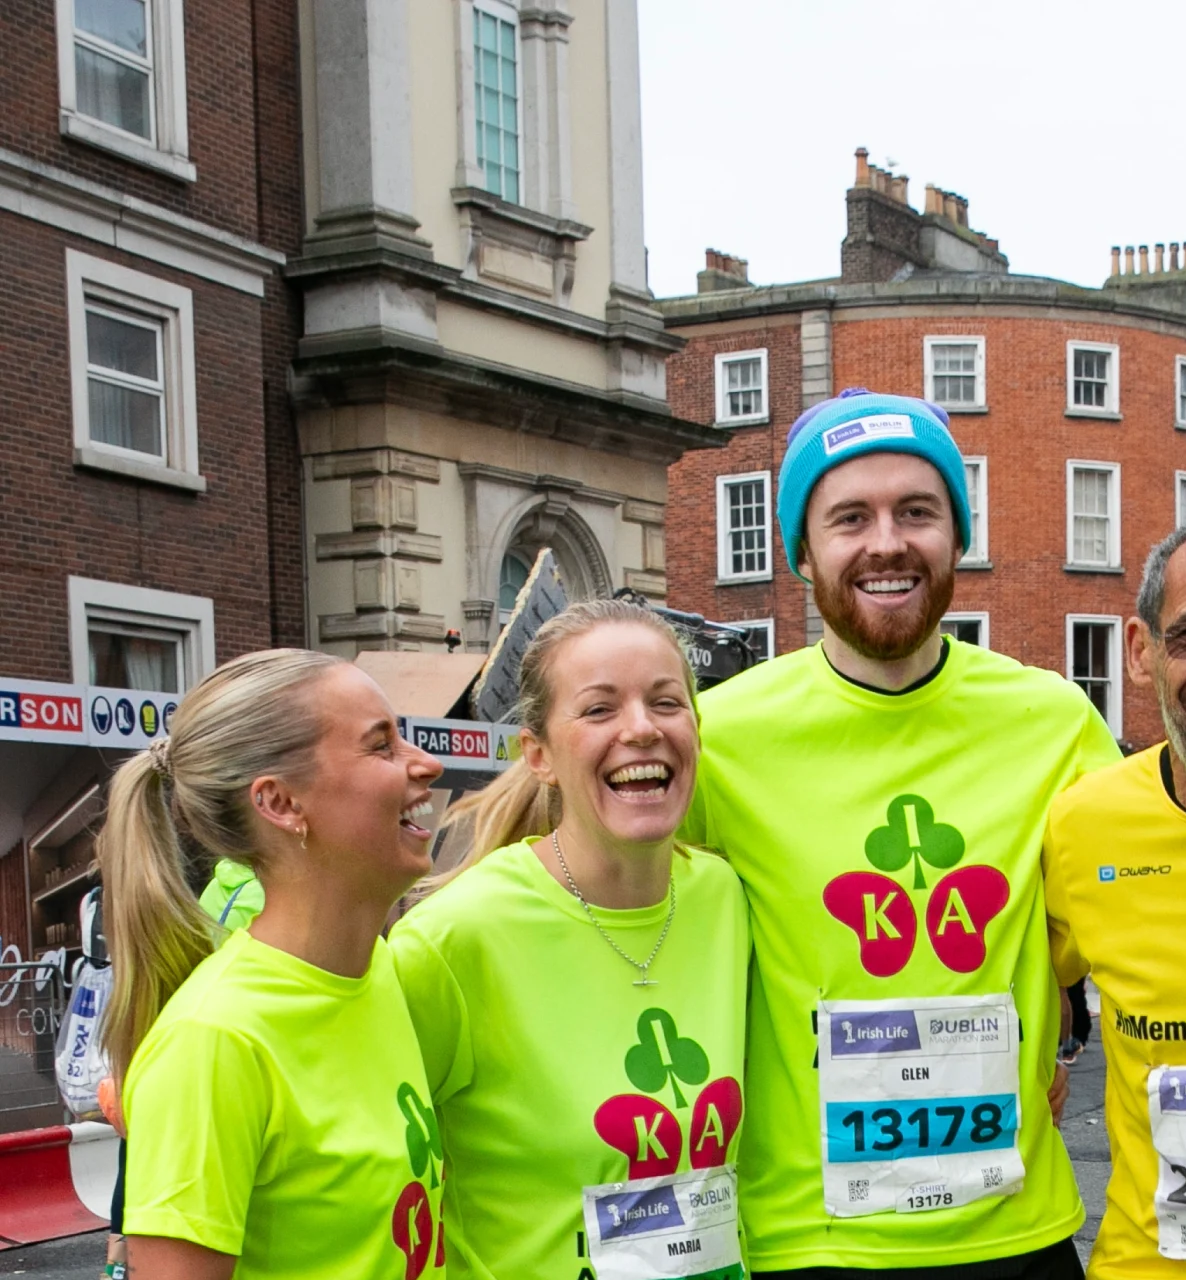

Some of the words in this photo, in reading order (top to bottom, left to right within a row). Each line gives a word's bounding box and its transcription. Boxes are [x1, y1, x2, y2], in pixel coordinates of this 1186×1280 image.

[417, 730, 488, 754] PARSON
[857, 1026, 884, 1039] Irish
[886, 1025, 909, 1039] Life
[930, 1017, 999, 1035] DUBLIN
[980, 1034, 999, 1042] 2024
[902, 1067, 929, 1081] GLEN
[842, 1103, 1003, 1152] 13178
[689, 1186, 731, 1208] DUBLIN
[910, 1184, 947, 1195] T-SHIRT
[907, 1193, 953, 1209] 13178
[624, 1207, 646, 1220] Irish
[648, 1203, 669, 1216] Life
[667, 1238, 702, 1257] MARIA
